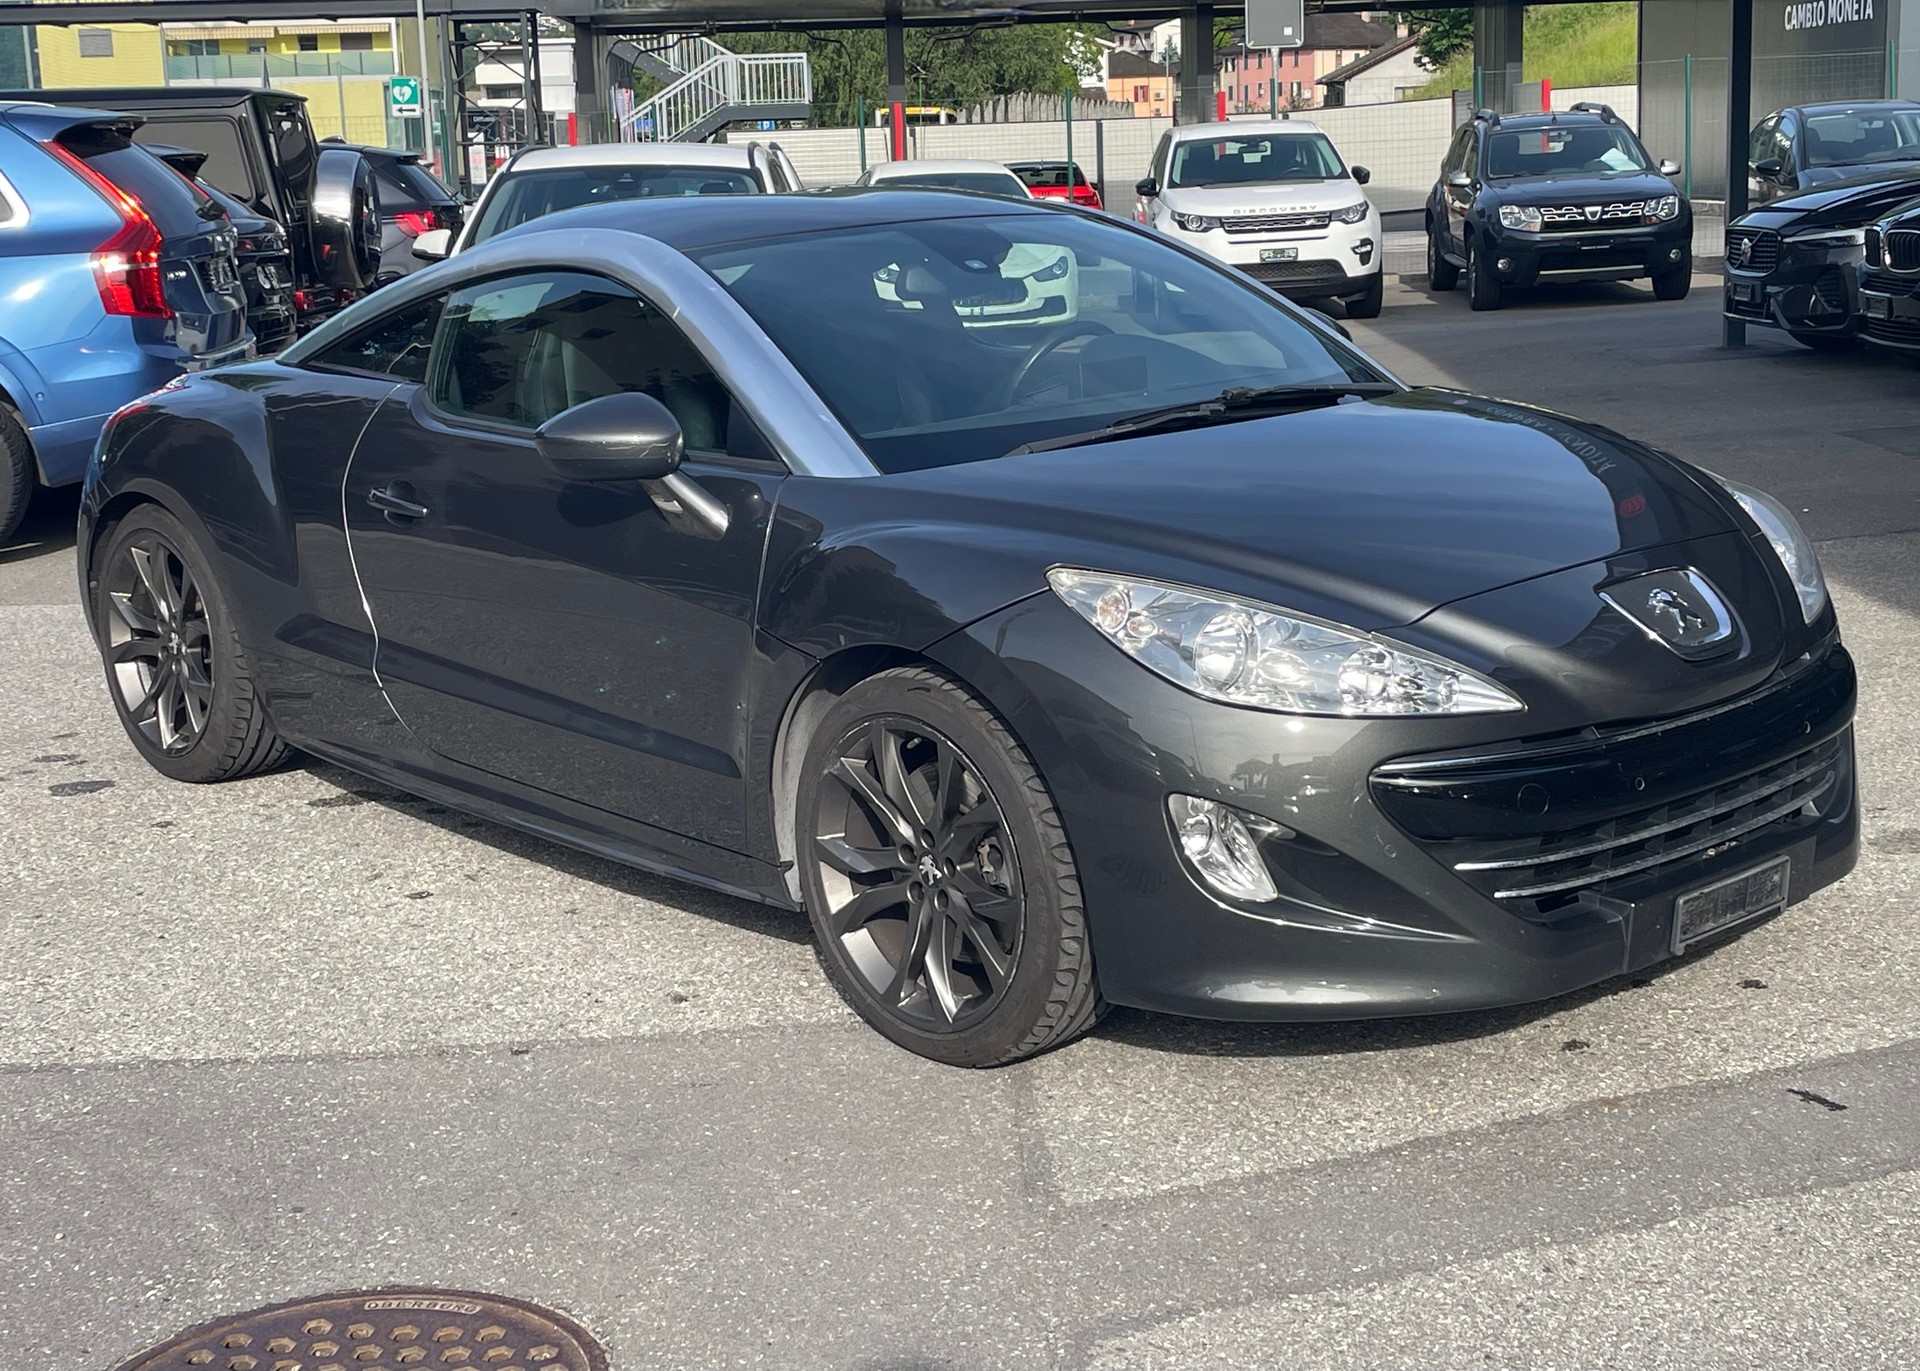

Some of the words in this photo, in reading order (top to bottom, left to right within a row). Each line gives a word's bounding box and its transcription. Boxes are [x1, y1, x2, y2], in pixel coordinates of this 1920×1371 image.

[1784, 1, 1825, 31] CAMBIO
[1827, 0, 1874, 25] MONETA
[1233, 205, 1317, 214] DISCOVERY
